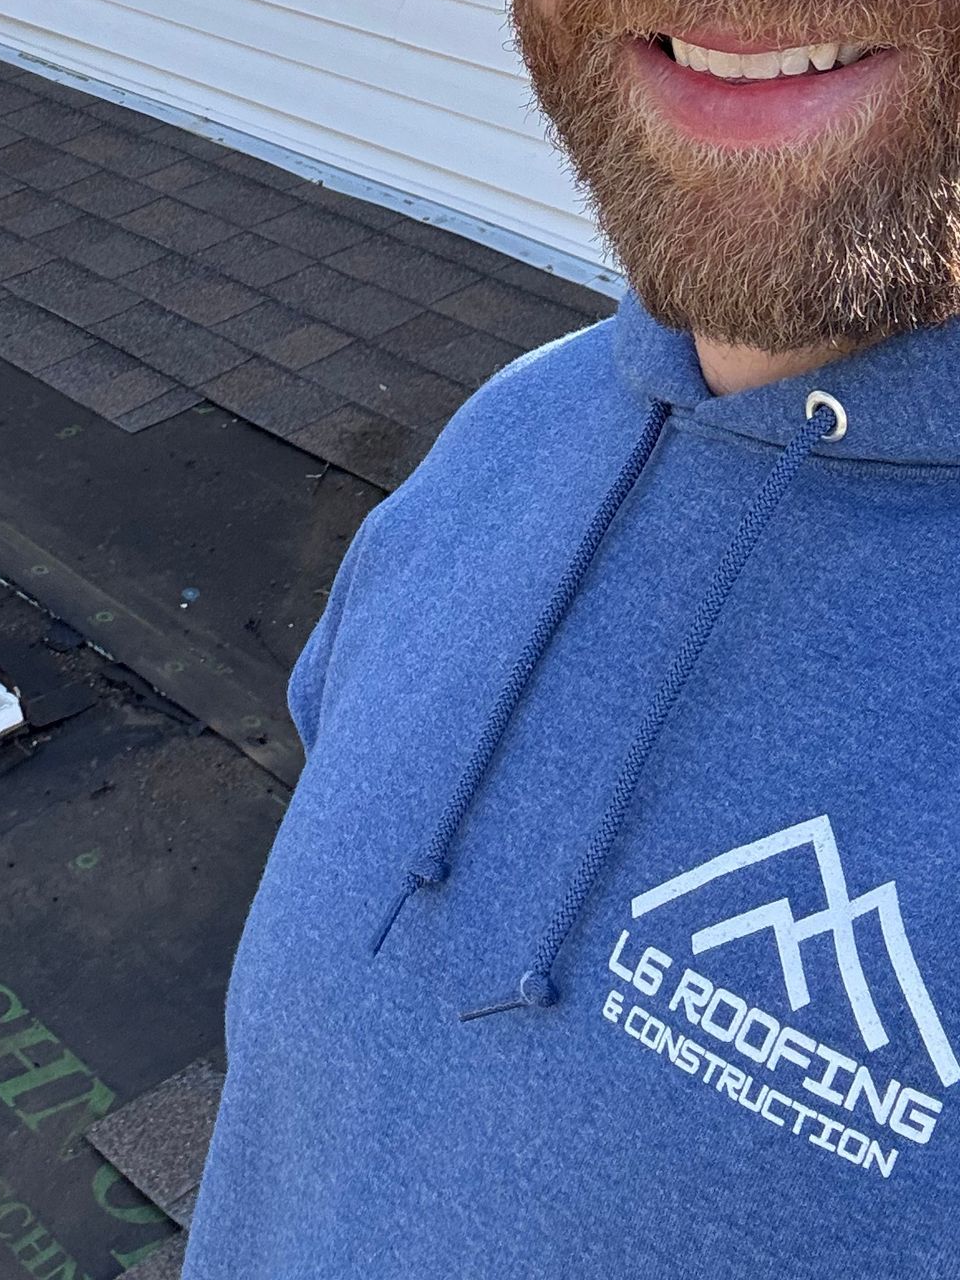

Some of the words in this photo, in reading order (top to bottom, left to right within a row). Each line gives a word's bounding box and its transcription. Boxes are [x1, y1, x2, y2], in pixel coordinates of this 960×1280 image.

[602, 989, 625, 1024] &
[624, 1005, 900, 1179] CONSTRUCTION
[608, 929, 673, 997] L6
[668, 968, 943, 1145] ROOFING
